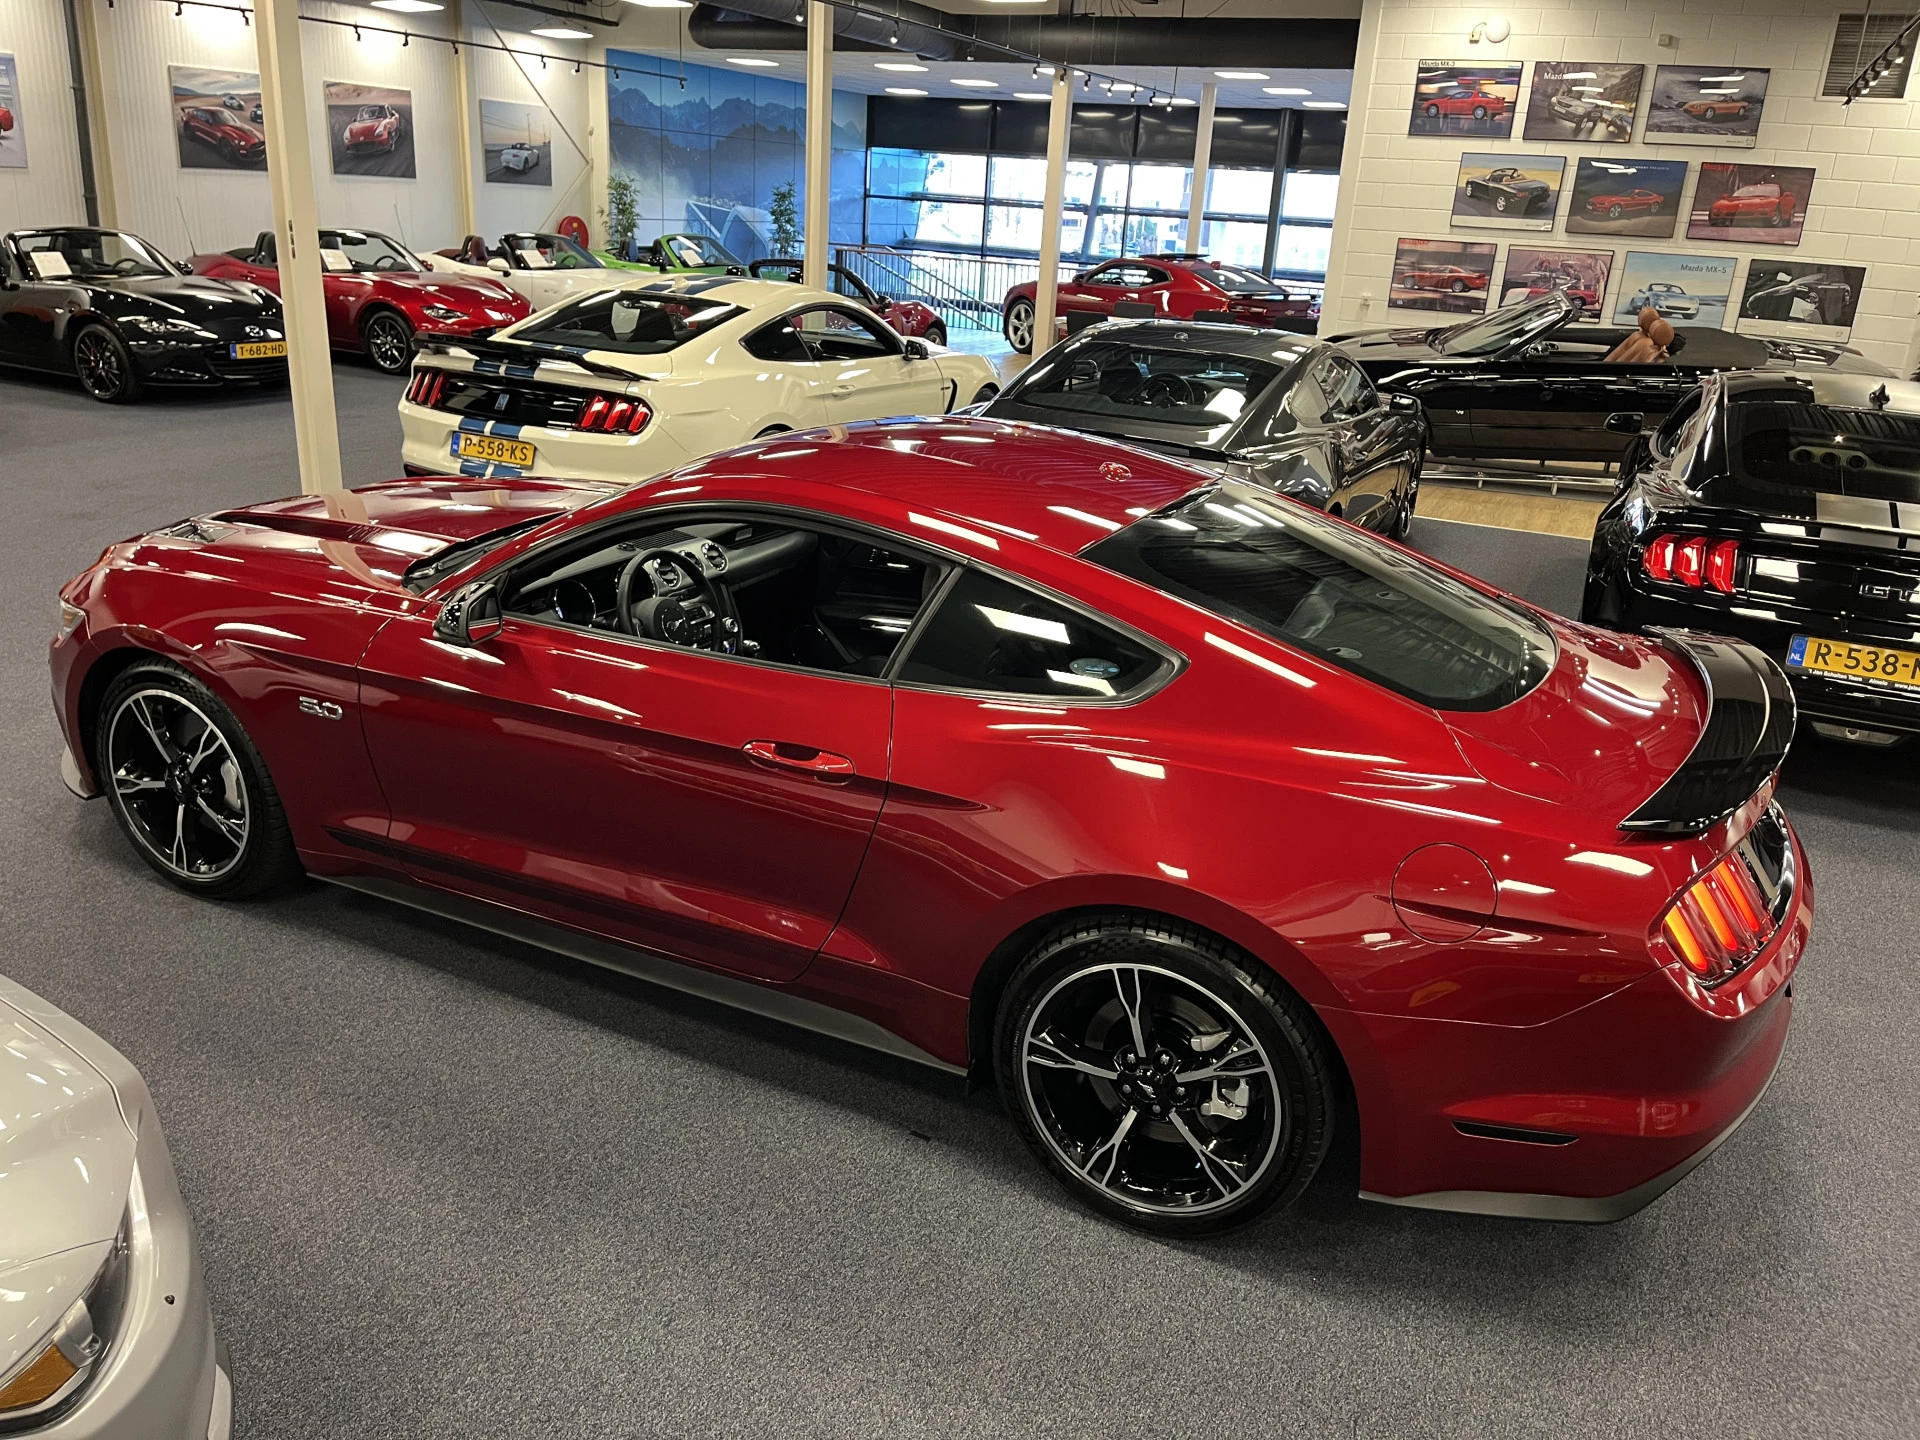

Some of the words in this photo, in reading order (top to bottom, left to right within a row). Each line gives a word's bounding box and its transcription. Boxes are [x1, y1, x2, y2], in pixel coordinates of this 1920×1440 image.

[1680, 263, 1704, 272] Mazda
[1705, 265, 1727, 274] MX-5
[239, 343, 284, 357] T-682-HD
[463, 437, 529, 461] P-558-KS
[1790, 652, 1802, 661] NL
[1848, 674, 1863, 682] Team
[299, 696, 343, 720] 5.0
